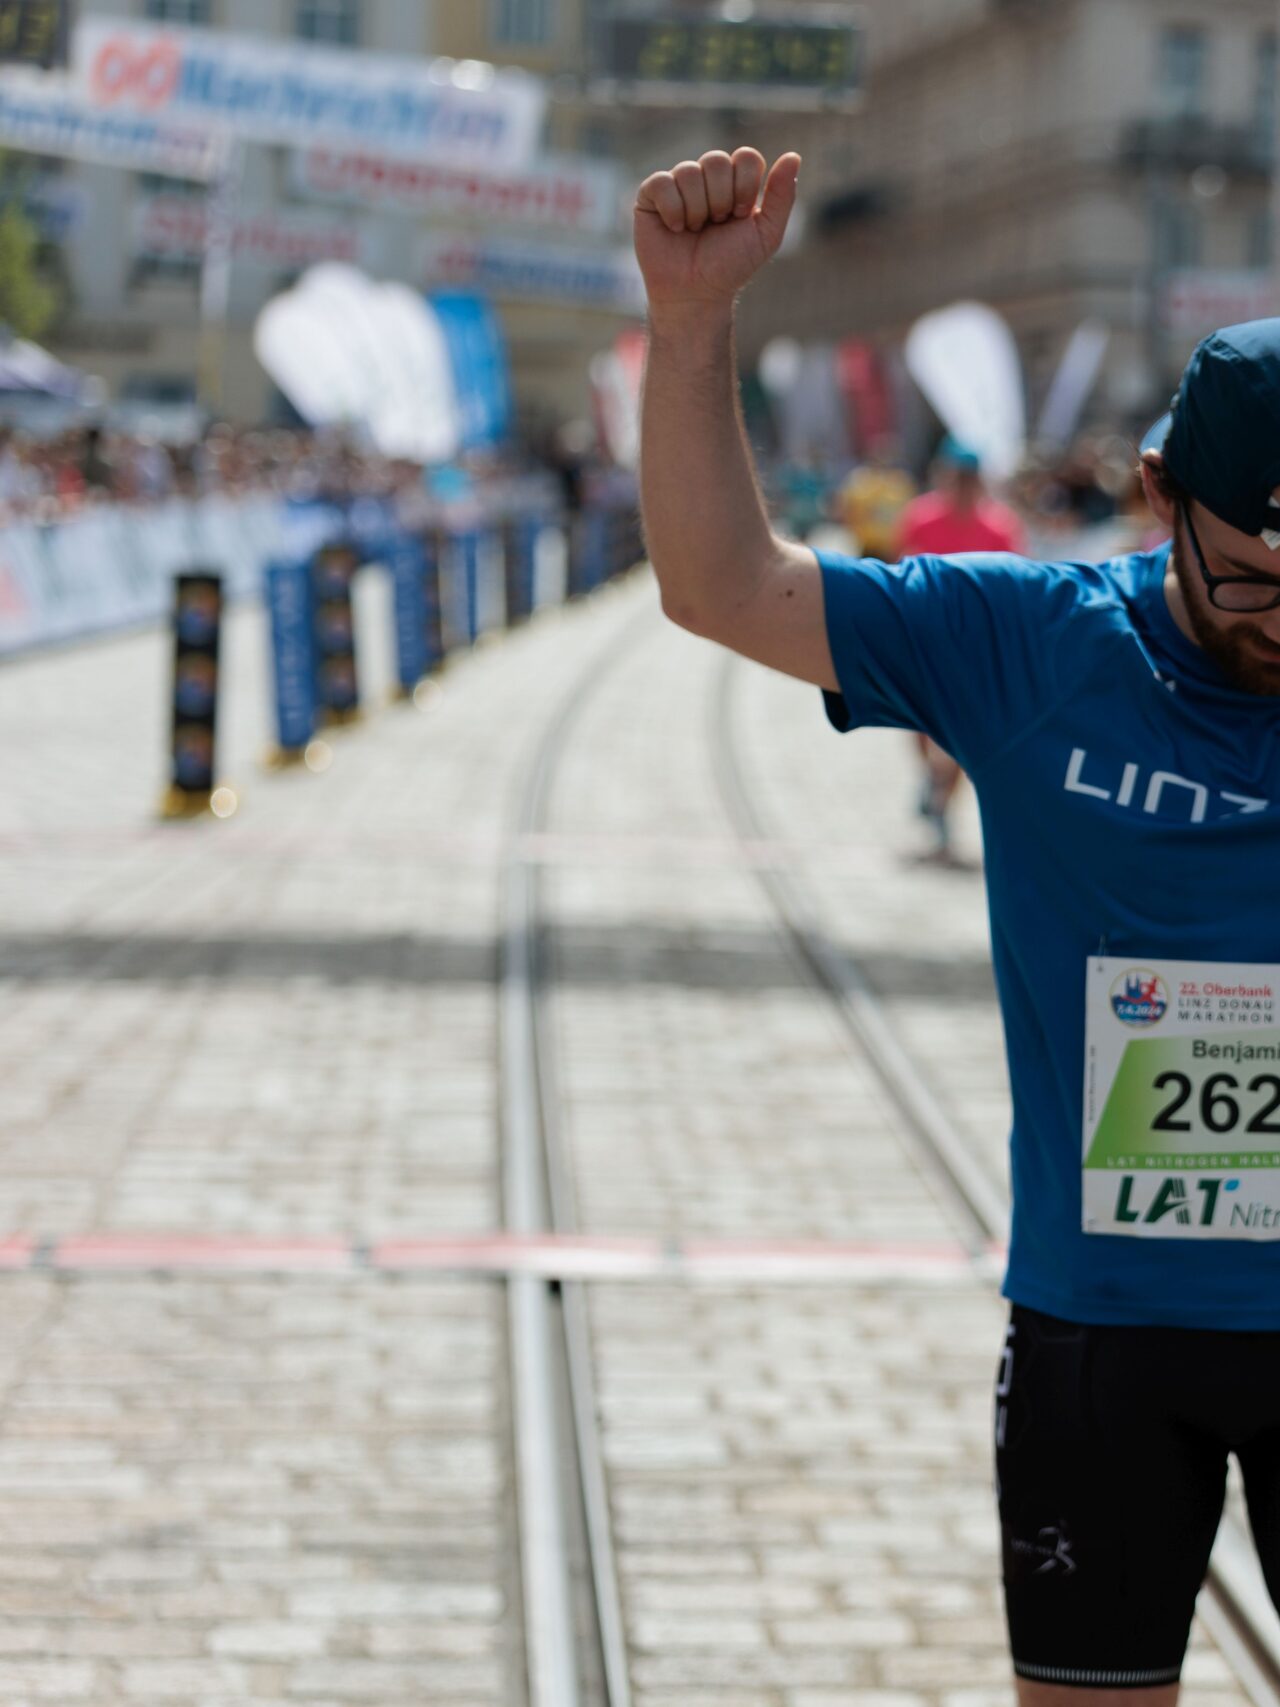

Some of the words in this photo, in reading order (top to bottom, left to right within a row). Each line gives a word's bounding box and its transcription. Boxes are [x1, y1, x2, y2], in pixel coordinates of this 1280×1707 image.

[1202, 982, 1273, 998] Oberbank
[1178, 998, 1212, 1009] LINZ
[1218, 998, 1274, 1010] DONAU
[1177, 1010, 1274, 1023] MARATHON
[1106, 1156, 1138, 1168] LAT
[1144, 1156, 1232, 1168] NITROGEN
[1114, 1174, 1224, 1227] LAT
